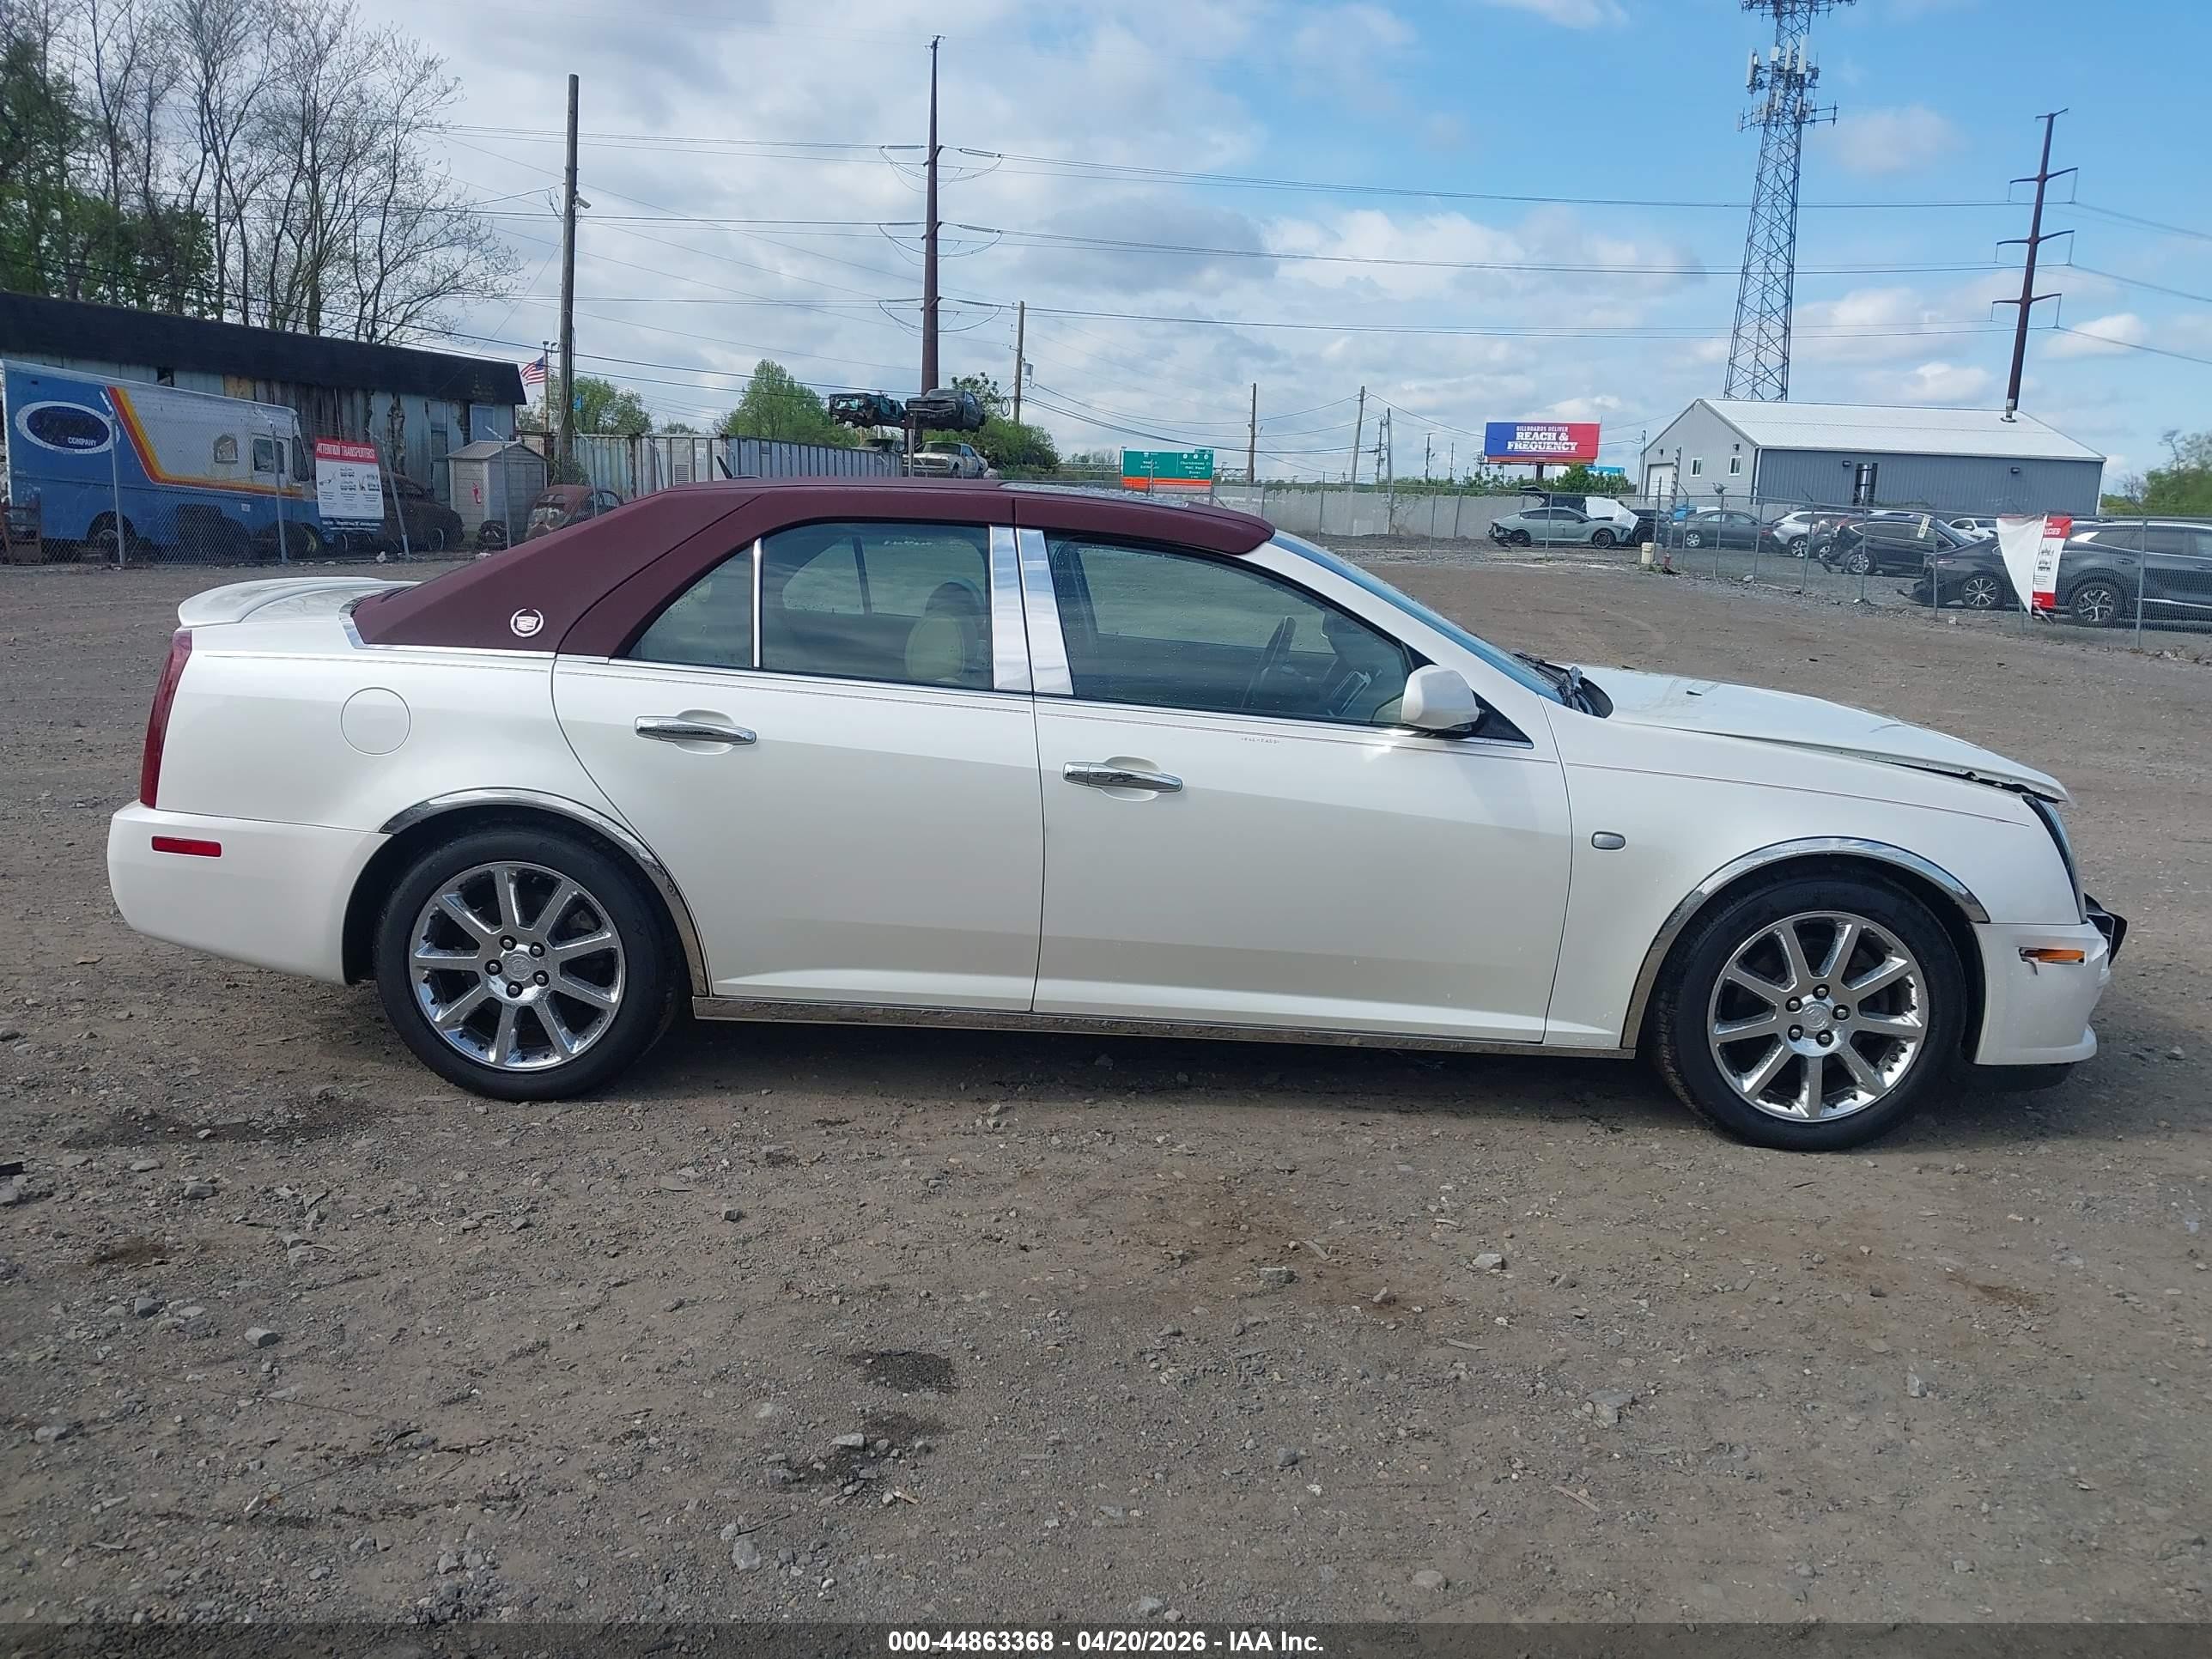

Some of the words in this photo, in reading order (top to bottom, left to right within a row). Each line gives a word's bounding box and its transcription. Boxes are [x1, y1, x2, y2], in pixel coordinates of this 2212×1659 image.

[68, 436, 97, 447] COMPANY
[1516, 432, 1556, 441] REACH
[1559, 433, 1569, 441] &
[317, 442, 340, 456] ATTENTION
[1507, 441, 1578, 451] FREQUENCY
